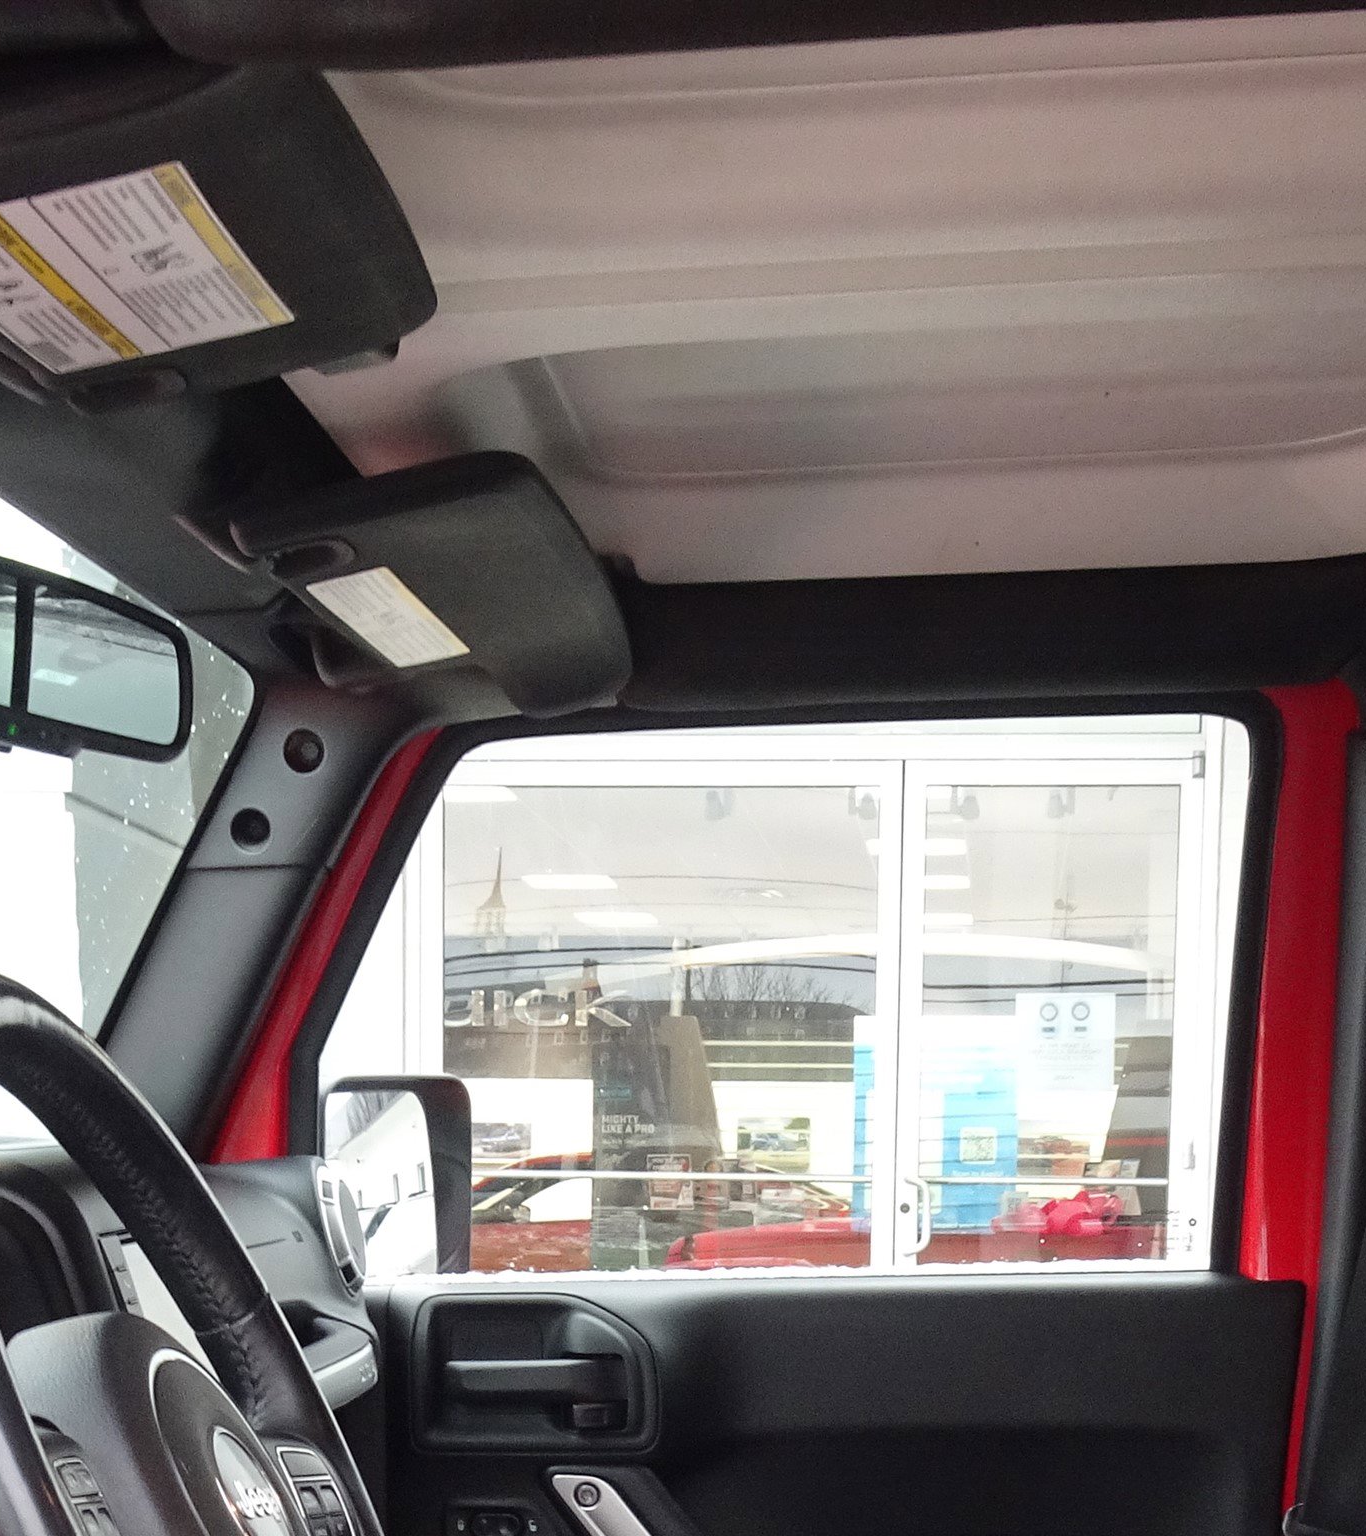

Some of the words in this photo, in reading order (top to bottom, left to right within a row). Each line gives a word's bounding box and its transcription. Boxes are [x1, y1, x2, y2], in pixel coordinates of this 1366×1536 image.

[601, 1114, 639, 1124] MIGHTY
[601, 1124, 622, 1134] LIKE
[625, 1124, 633, 1134] A
[635, 1124, 655, 1134] PRO
